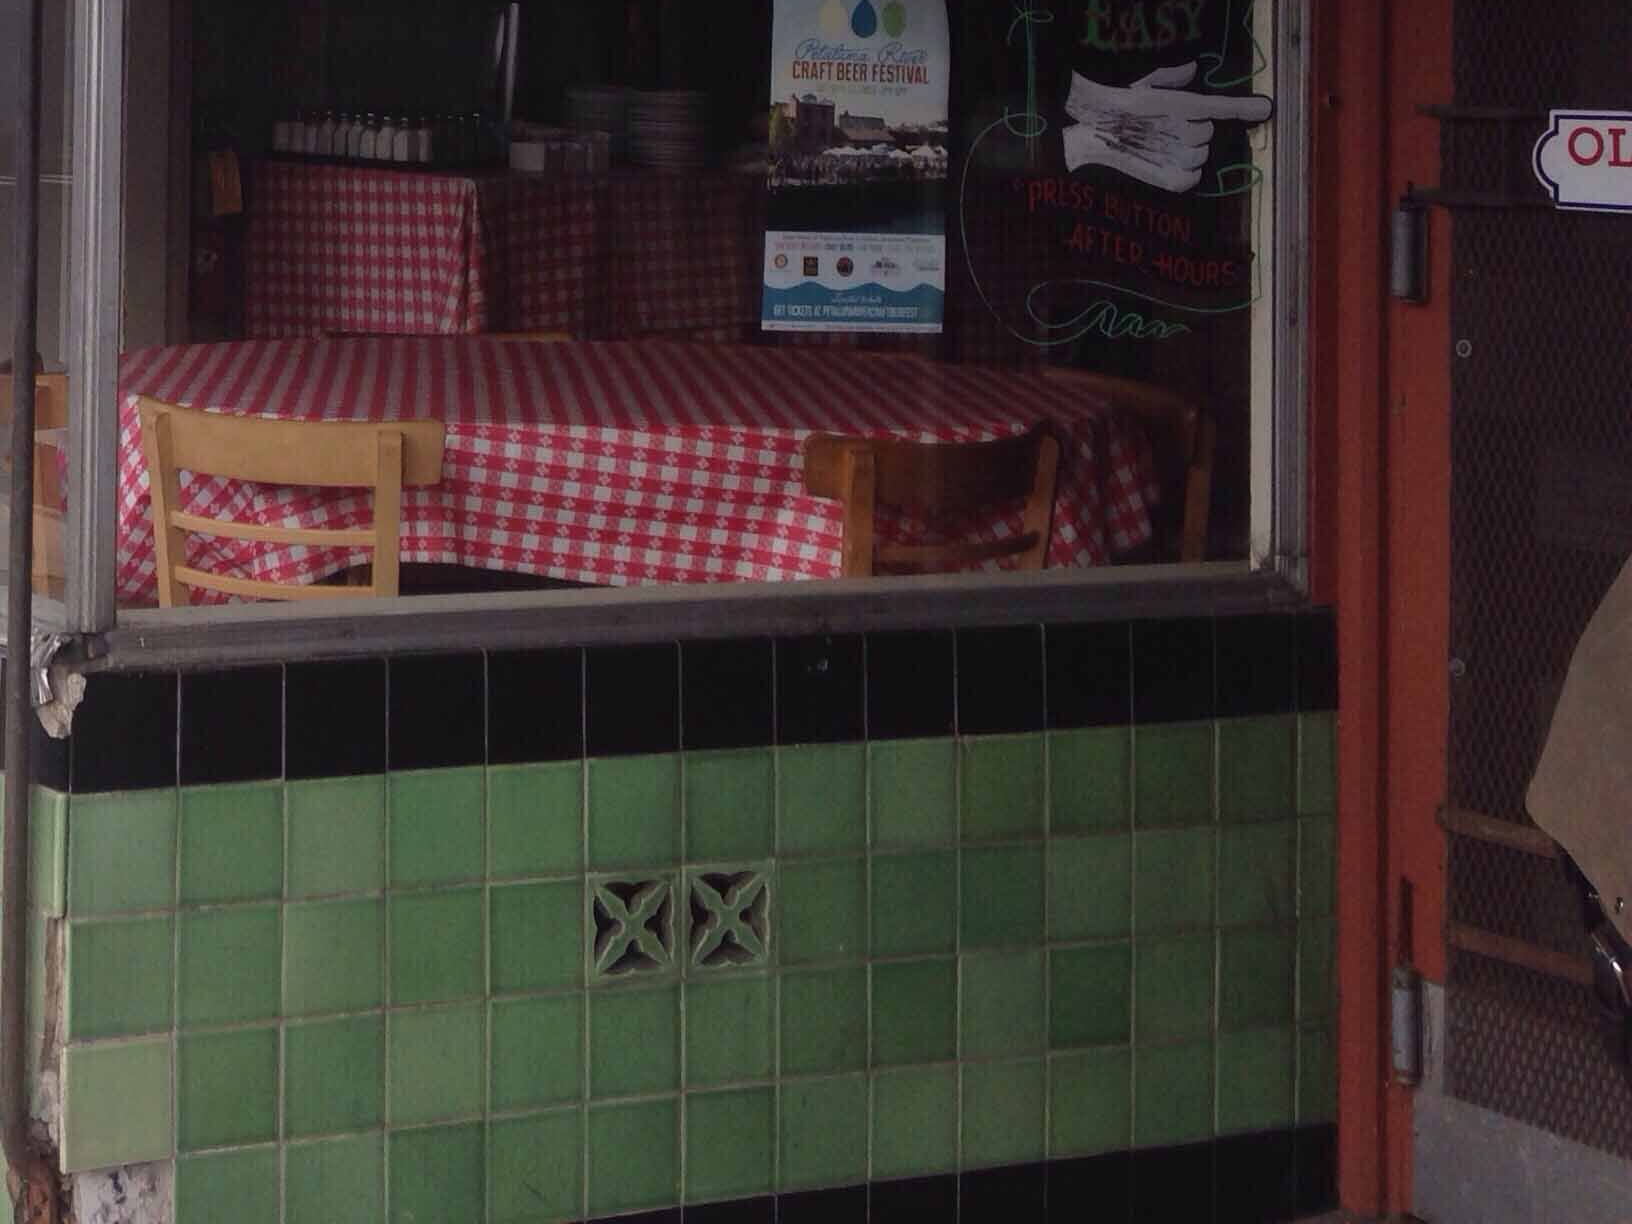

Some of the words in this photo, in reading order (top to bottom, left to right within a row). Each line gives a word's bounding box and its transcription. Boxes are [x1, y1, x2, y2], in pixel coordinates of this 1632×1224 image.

[792, 61, 834, 80] CRAFT
[836, 62, 868, 82] BEER
[871, 63, 930, 85] FESTIVAL
[1103, 191, 1193, 242] BUTTON
[1064, 217, 1145, 266] AFTER
